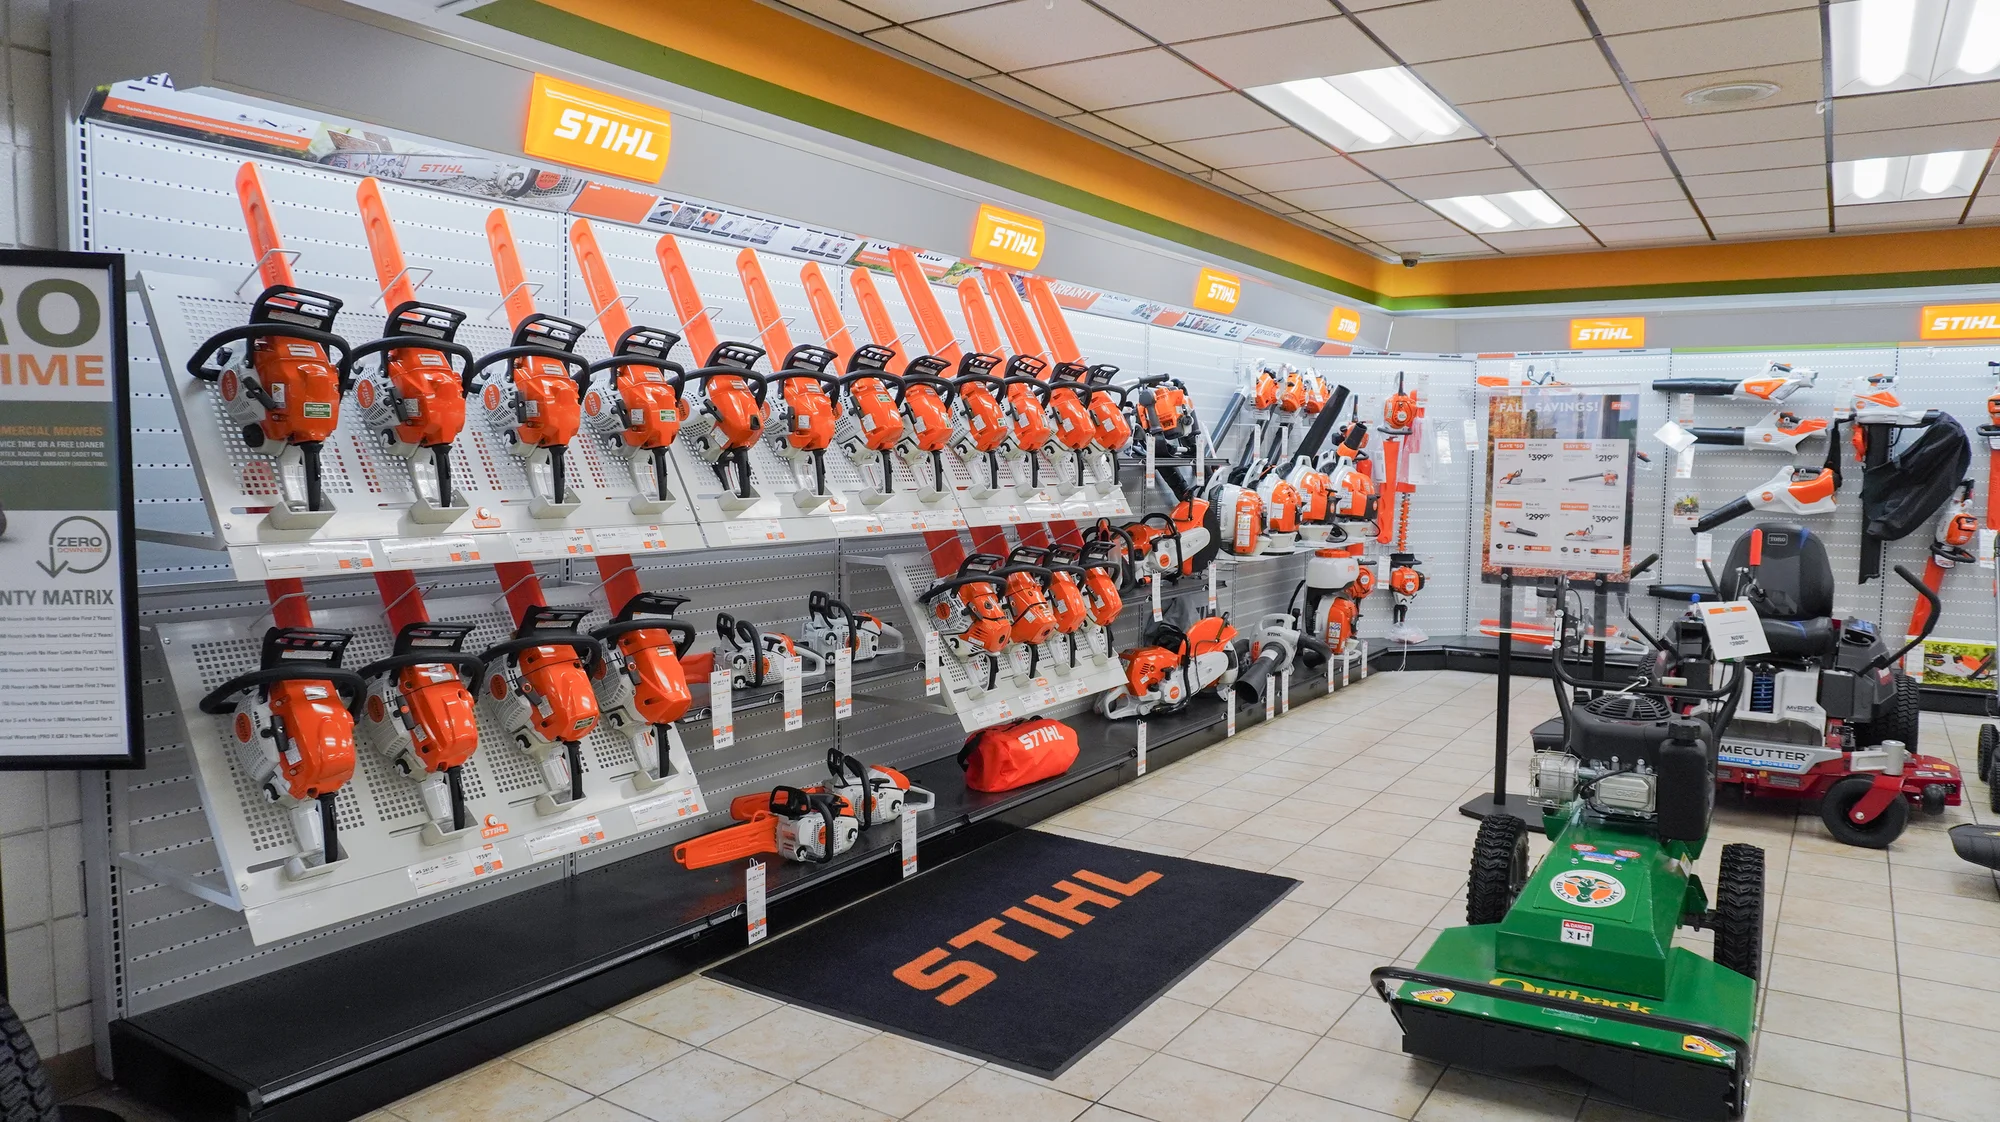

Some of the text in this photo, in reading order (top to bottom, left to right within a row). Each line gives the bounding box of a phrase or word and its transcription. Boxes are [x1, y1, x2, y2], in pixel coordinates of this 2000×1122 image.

[553, 108, 659, 161] STIHL
[418, 163, 465, 174] STIHL
[989, 226, 1038, 257] STIHL
[1207, 283, 1237, 304] STIHL
[0, 278, 101, 348] O
[1337, 318, 1358, 334] STIHL
[1931, 315, 2000, 331] STIHL
[1577, 327, 1633, 341] STIHL
[361, 381, 373, 406] STIHL
[490, 386, 499, 409] STIHL
[588, 394, 599, 414] STIHL
[1500, 401, 1599, 412] FALL SAVINGS!
[53, 426, 103, 436] MOWERS
[57, 441, 75, 449] FREE
[57, 537, 102, 547] ZERO
[43, 589, 114, 605] MATRIX
[1018, 725, 1064, 750] STIHL
[484, 827, 507, 836] STIHL
[1556, 882, 1620, 905] BILLY GOAT
[1570, 923, 1592, 931] DANGER
[892, 869, 1164, 1006] STIHL
[1417, 988, 1445, 996] DANGER
[1488, 977, 1652, 1014] Outback
